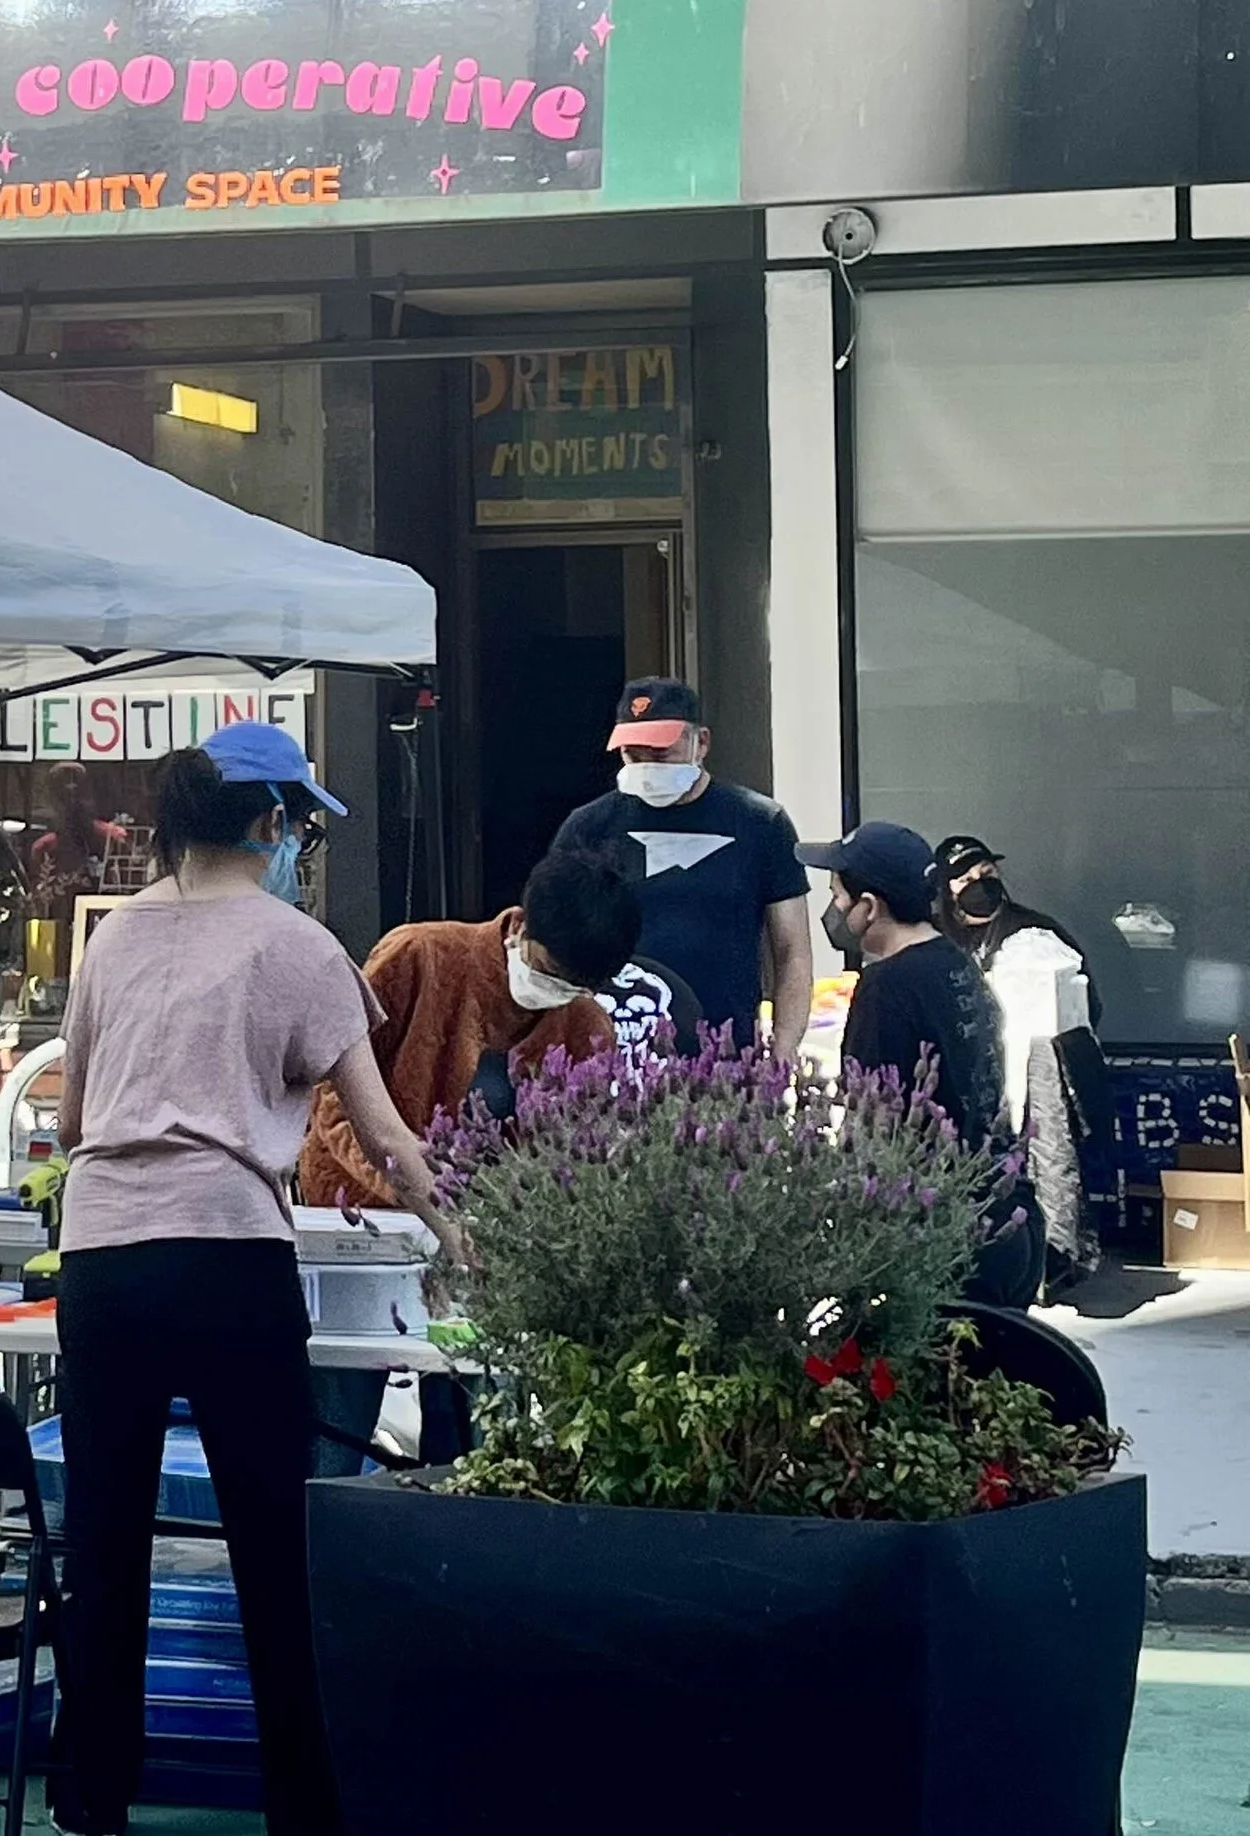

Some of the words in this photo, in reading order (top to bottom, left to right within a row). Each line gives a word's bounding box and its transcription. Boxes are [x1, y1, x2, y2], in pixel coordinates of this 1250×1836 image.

[16, 54, 587, 140] cooperative
[185, 165, 342, 210] SPACE
[472, 346, 674, 419] DREAM
[490, 432, 670, 477] MOMENTS
